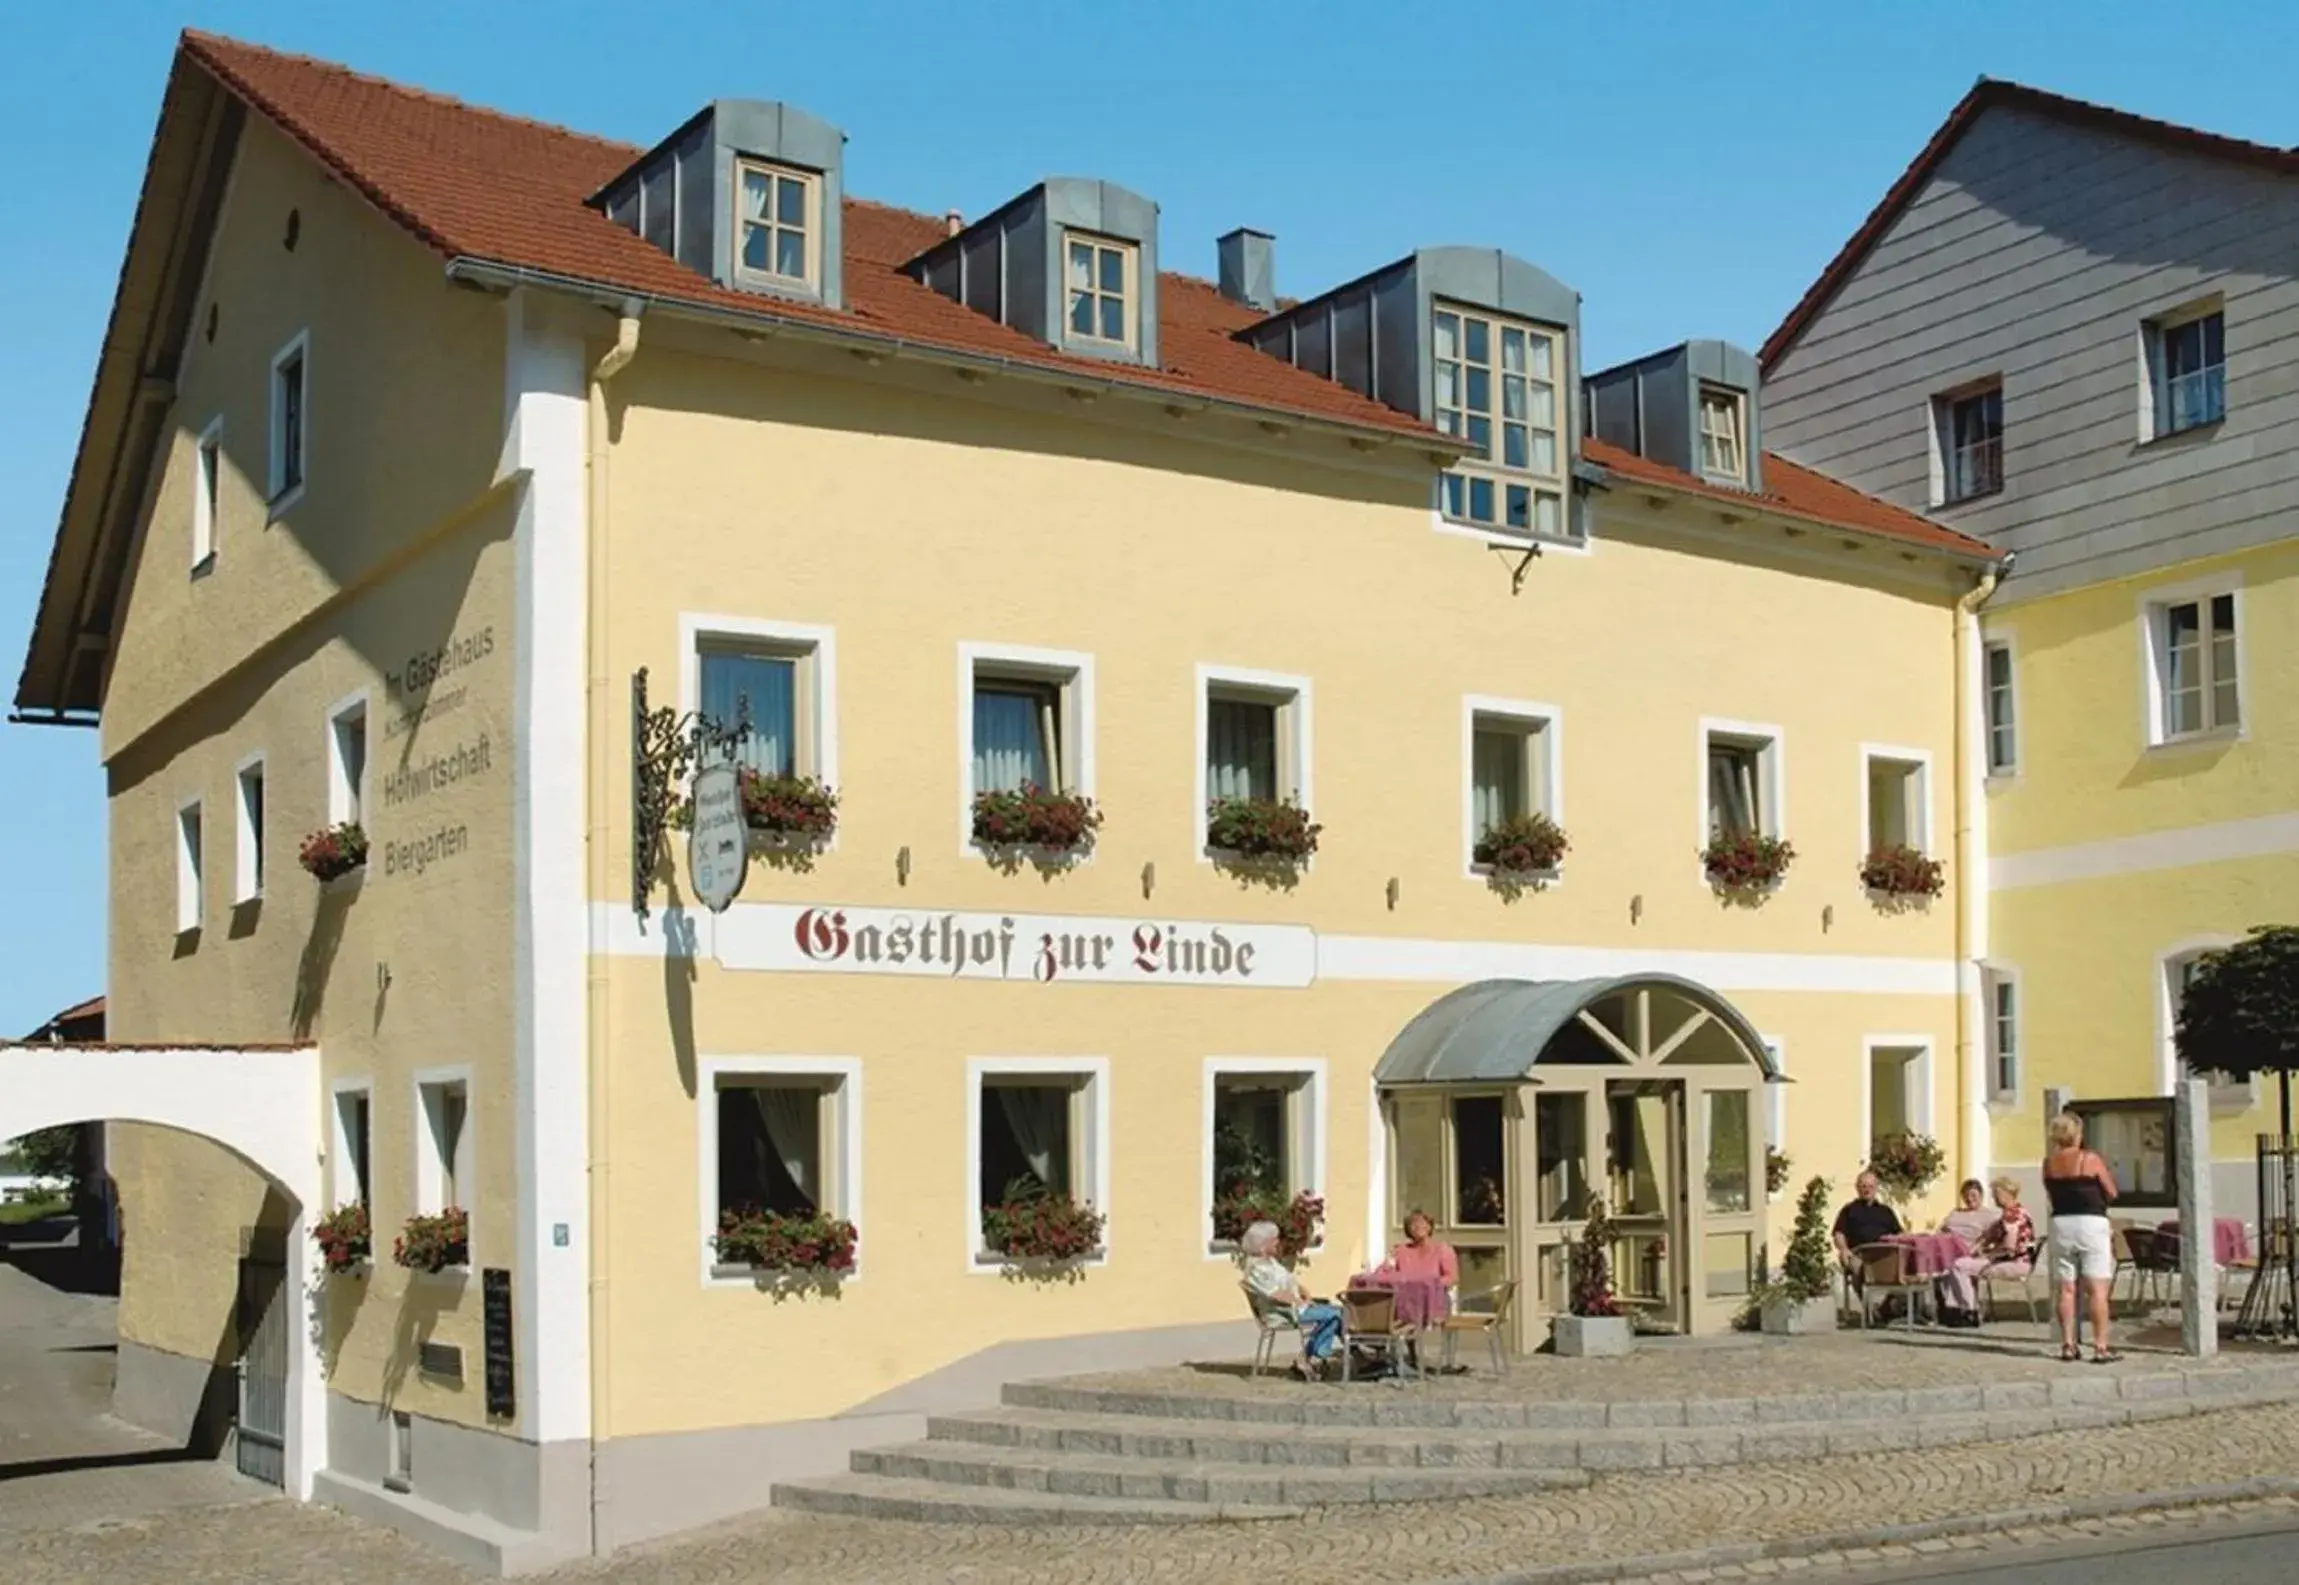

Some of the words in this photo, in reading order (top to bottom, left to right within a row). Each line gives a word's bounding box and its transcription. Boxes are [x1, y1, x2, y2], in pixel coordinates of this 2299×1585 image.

[406, 627, 494, 693] Gästehaus
[384, 824, 468, 876] Biergarten
[794, 906, 1015, 978] Gasthof
[1033, 931, 1114, 982] zur
[1132, 923, 1255, 975] Linde
